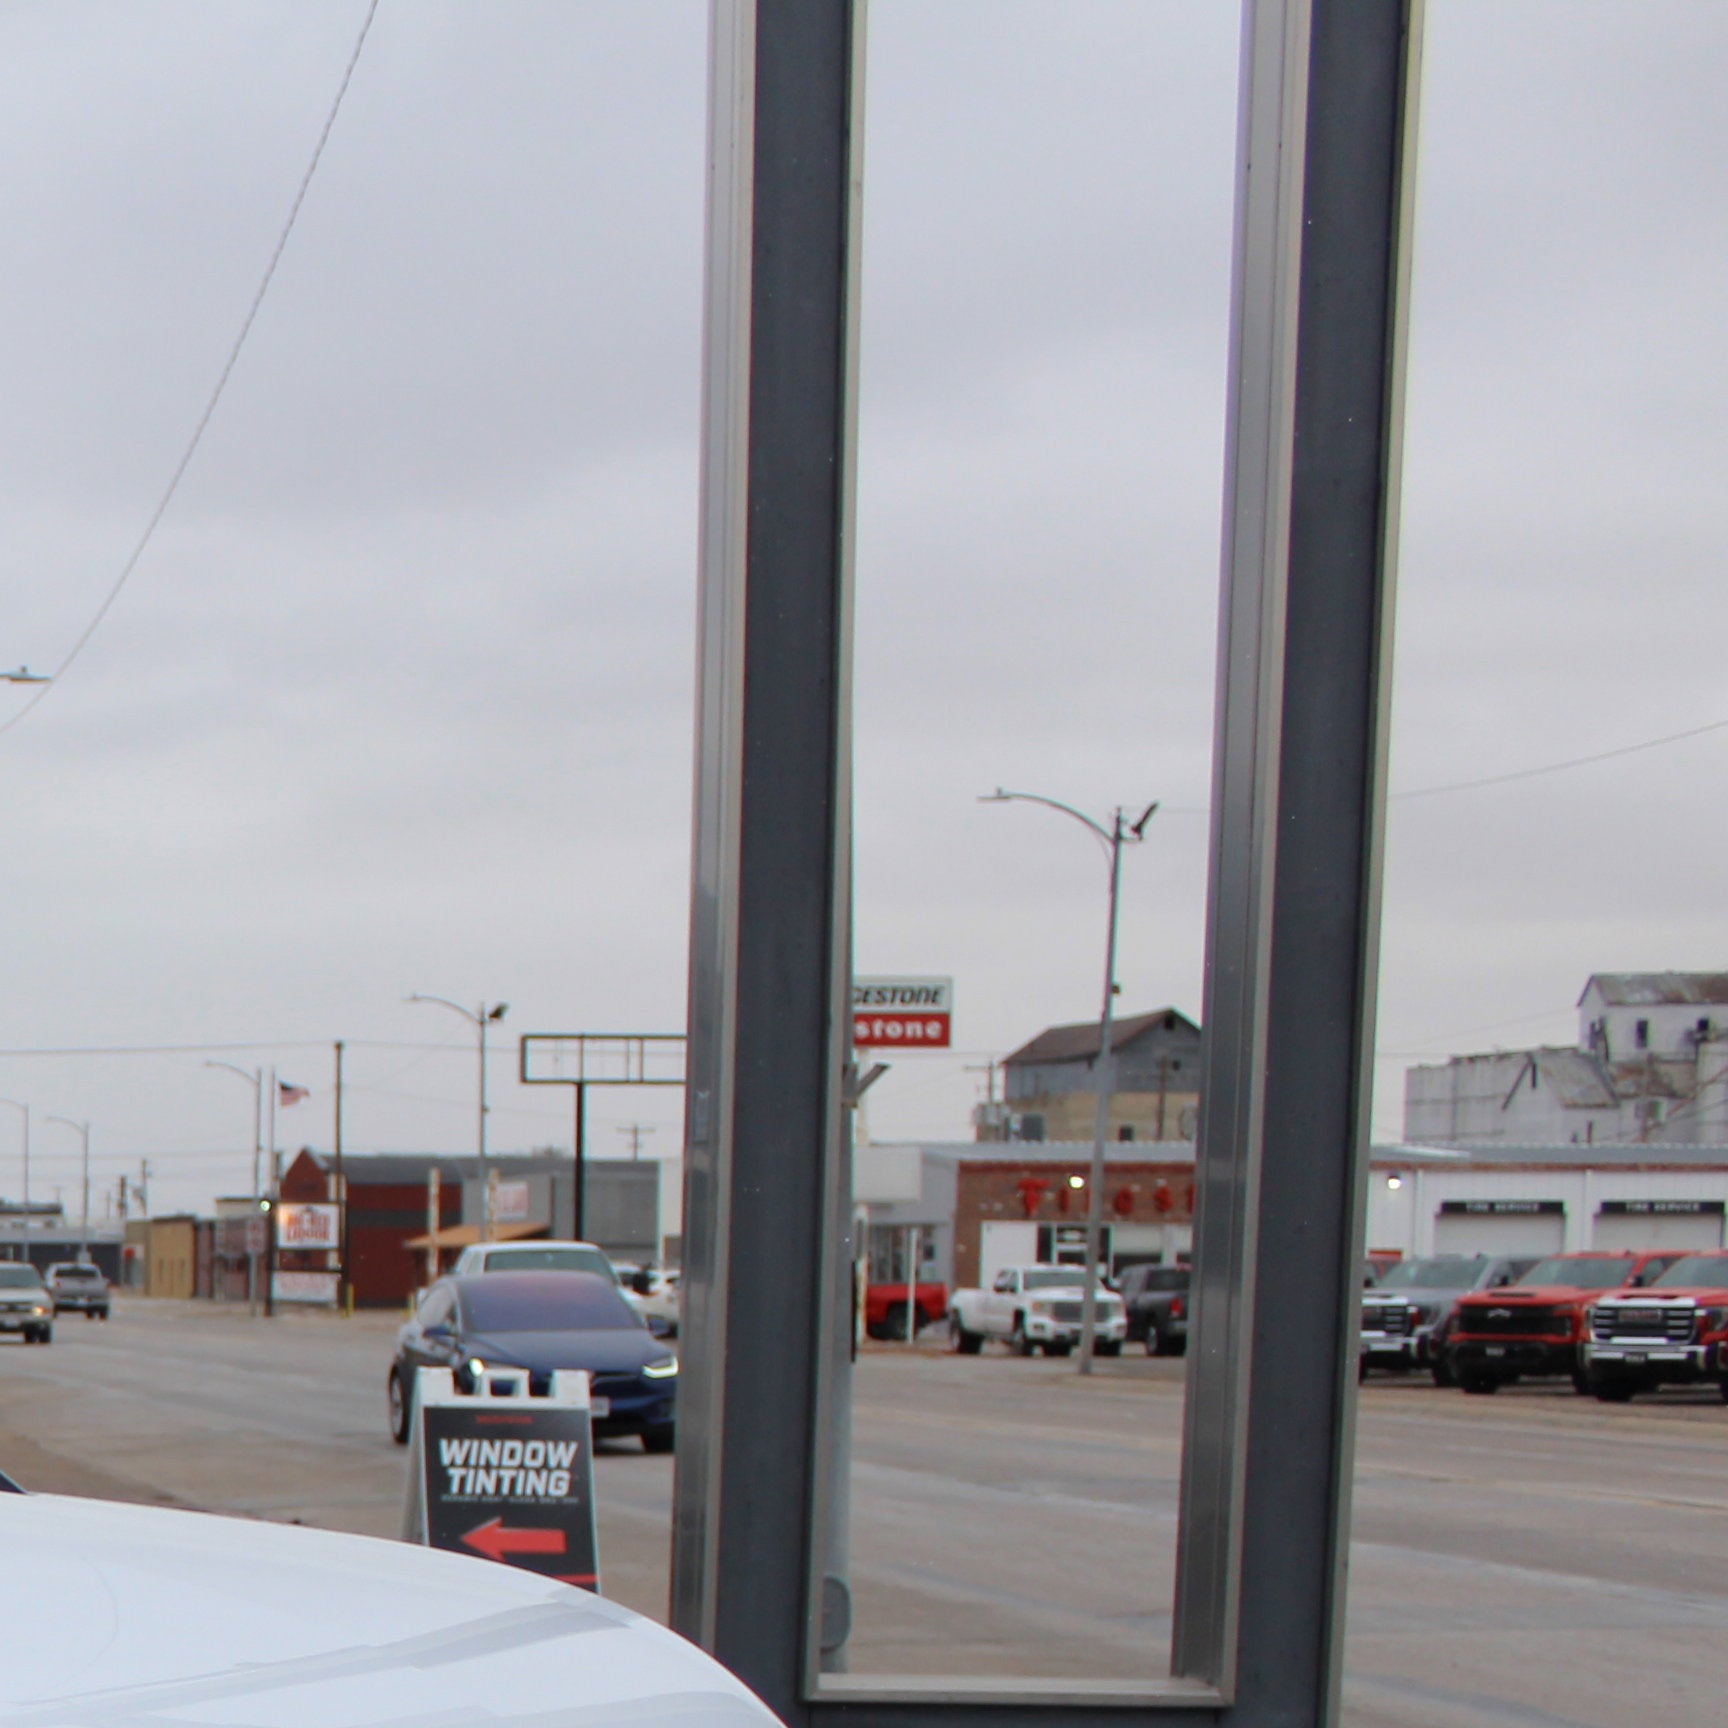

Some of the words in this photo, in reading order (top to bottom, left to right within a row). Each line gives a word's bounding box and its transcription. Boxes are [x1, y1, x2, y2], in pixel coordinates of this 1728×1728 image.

[855, 1018, 943, 1040] stone
[439, 1438, 578, 1469] WINDOW
[446, 1467, 571, 1497] TINTING
